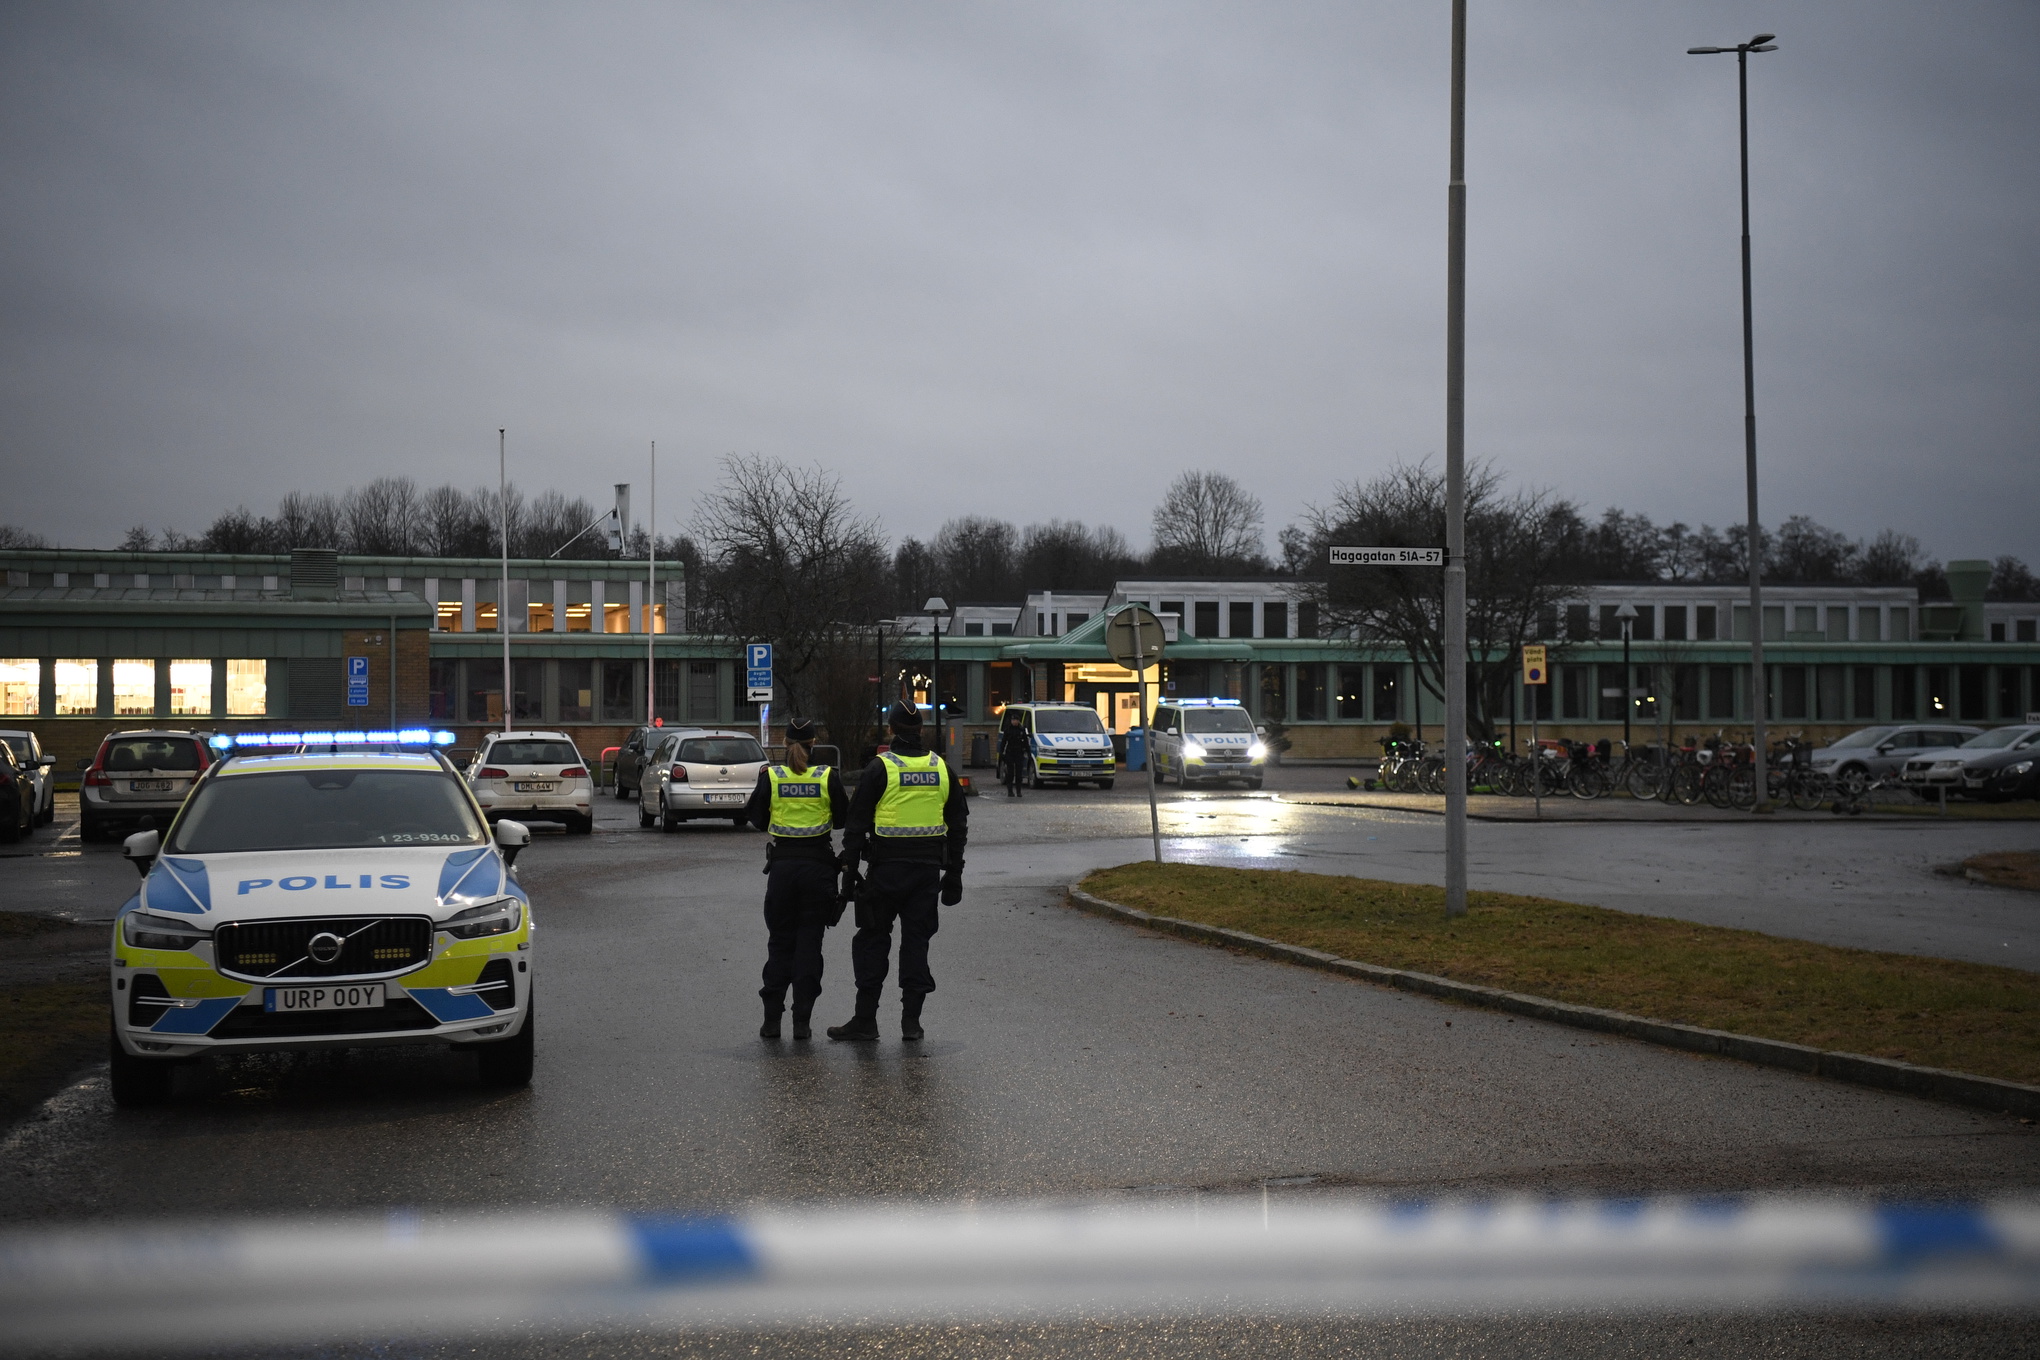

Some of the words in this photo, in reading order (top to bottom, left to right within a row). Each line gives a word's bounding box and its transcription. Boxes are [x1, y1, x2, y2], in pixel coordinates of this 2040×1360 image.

[1332, 550, 1396, 563] Hagagatan
[1400, 551, 1440, 562] 51A-57
[753, 646, 768, 667] P
[353, 659, 365, 674] P
[903, 773, 936, 784] POLIS
[781, 784, 817, 796] POLIS
[392, 833, 460, 842] 23-9340
[237, 874, 411, 895] POLIS
[284, 989, 325, 1009] URP
